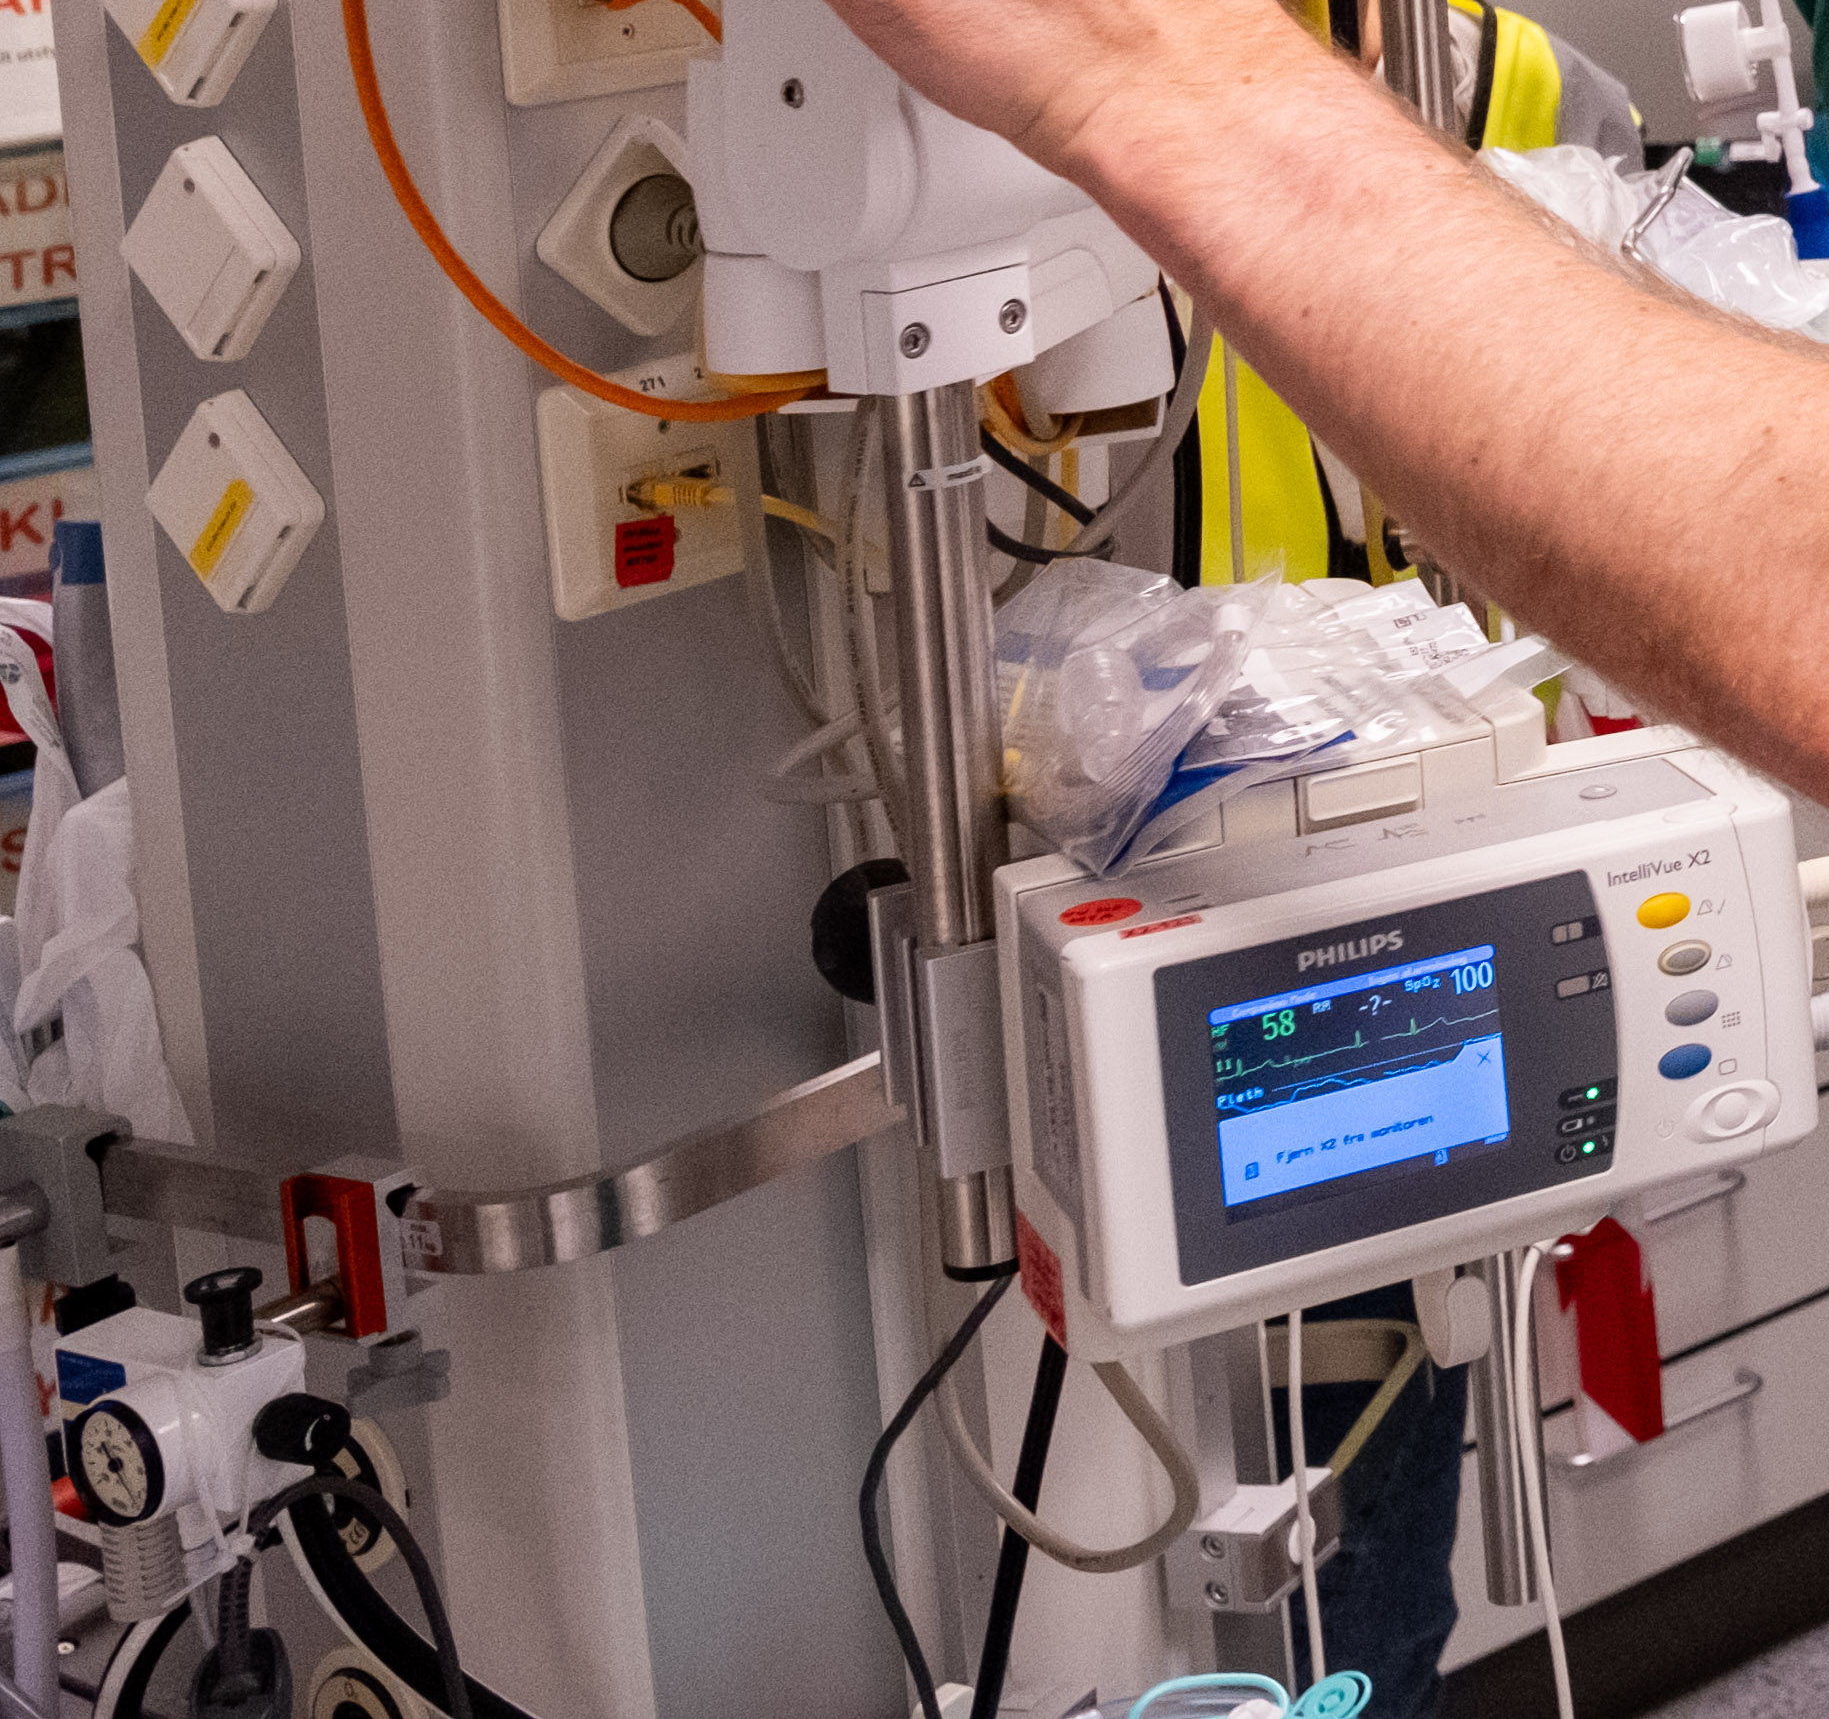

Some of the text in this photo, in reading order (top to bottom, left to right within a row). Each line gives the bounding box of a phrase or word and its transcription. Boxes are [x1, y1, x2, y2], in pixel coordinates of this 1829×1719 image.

[1607, 849, 1712, 887] IntelliVue X2
[1297, 930, 1404, 972] PHILIPS
[1450, 961, 1494, 996] 100
[1262, 1009, 1296, 1041] 58
[1276, 1145, 1315, 1164] Fjern
